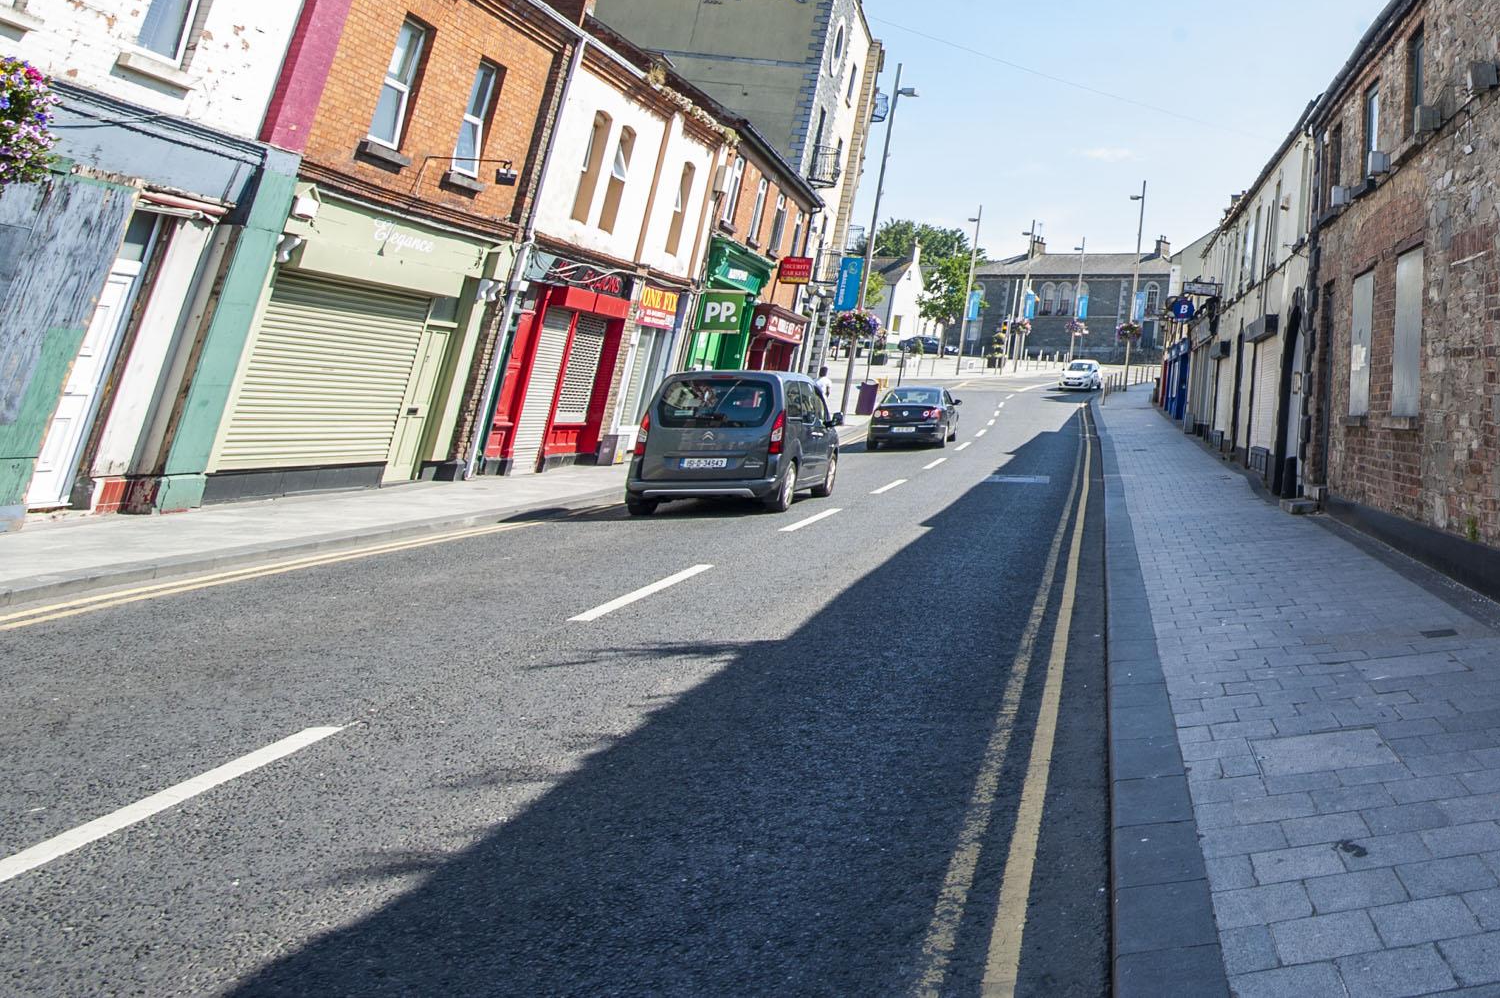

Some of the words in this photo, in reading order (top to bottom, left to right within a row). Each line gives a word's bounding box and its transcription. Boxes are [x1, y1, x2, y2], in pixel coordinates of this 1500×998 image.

[374, 217, 433, 252] Elegance
[642, 287, 662, 309] ONE
[1180, 304, 1189, 314] B
[704, 301, 738, 323] PP.
